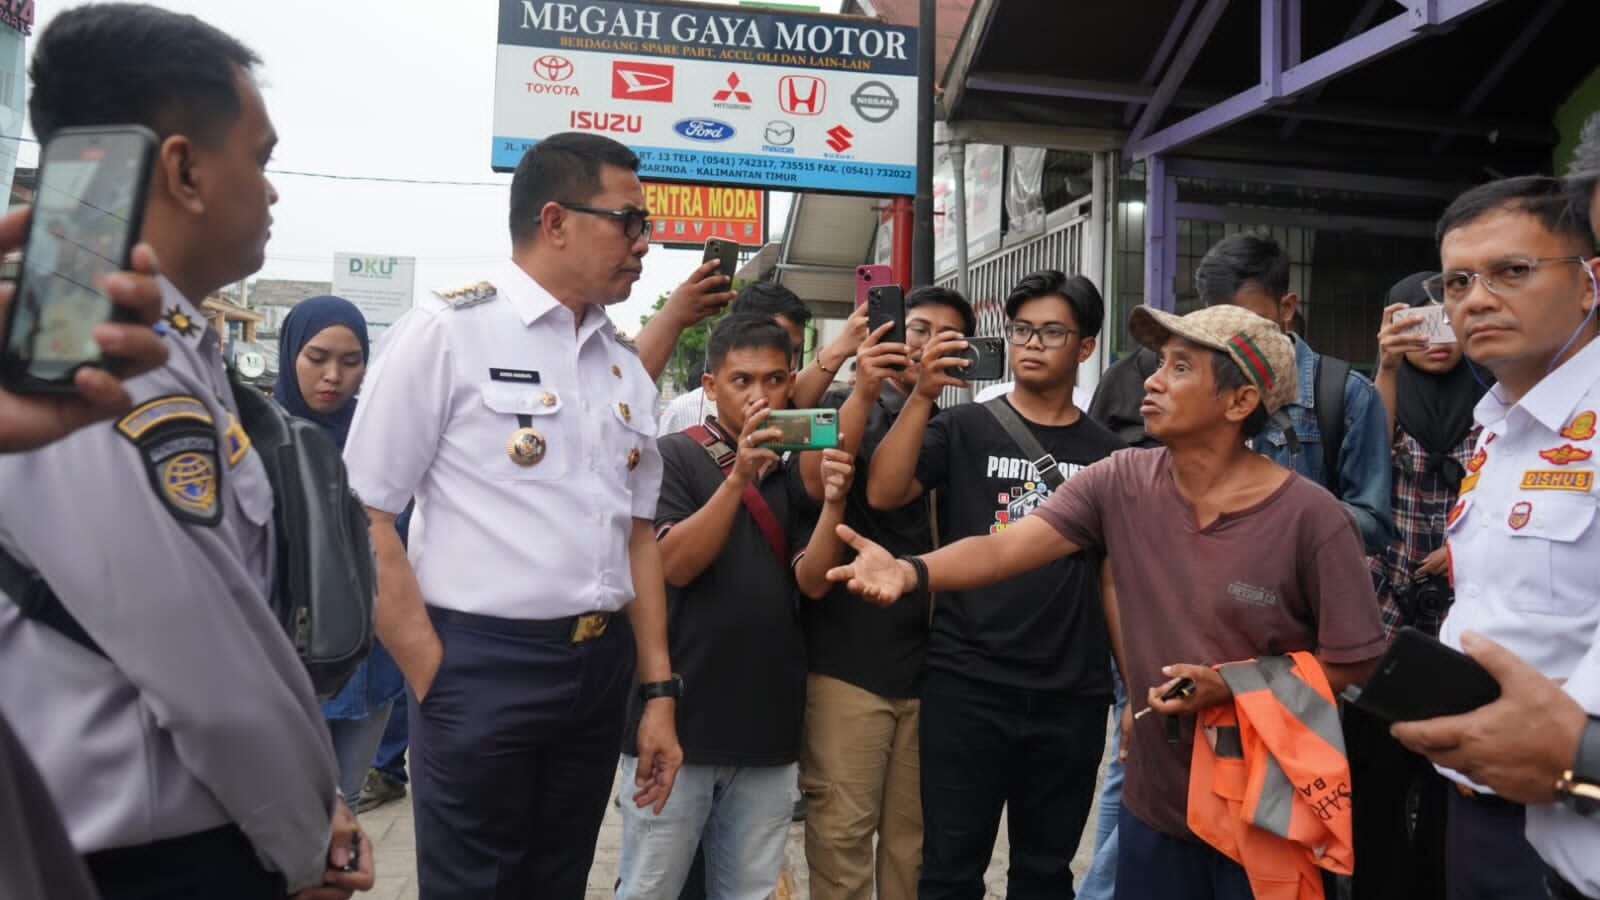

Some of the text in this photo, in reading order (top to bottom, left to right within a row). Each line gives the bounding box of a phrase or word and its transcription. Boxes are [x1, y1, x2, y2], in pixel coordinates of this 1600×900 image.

[520, 1, 907, 60] MEGAH GAYA MOTOR
[560, 36, 638, 52] BERDAGANG
[642, 43, 680, 56] SPARE
[757, 53, 777, 64] OLI
[781, 55, 806, 66] DAN
[809, 56, 871, 70] LAIN-LAIN
[526, 82, 580, 97] TOYOTA
[570, 110, 642, 133] ISUZU
[685, 119, 724, 139] Ford
[639, 163, 687, 175] MARINDA
[696, 166, 761, 180] KALIMANTAN
[765, 171, 797, 183] TIMUR
[659, 152, 669, 162] 13
[672, 153, 699, 164] TELP.
[702, 155, 735, 167] (0541)
[780, 161, 815, 172] 735515
[841, 165, 873, 178] (0541)
[877, 169, 912, 180] 732022
[641, 184, 758, 219] ENTRA MODA
[1525, 472, 1588, 488] DISHUB
